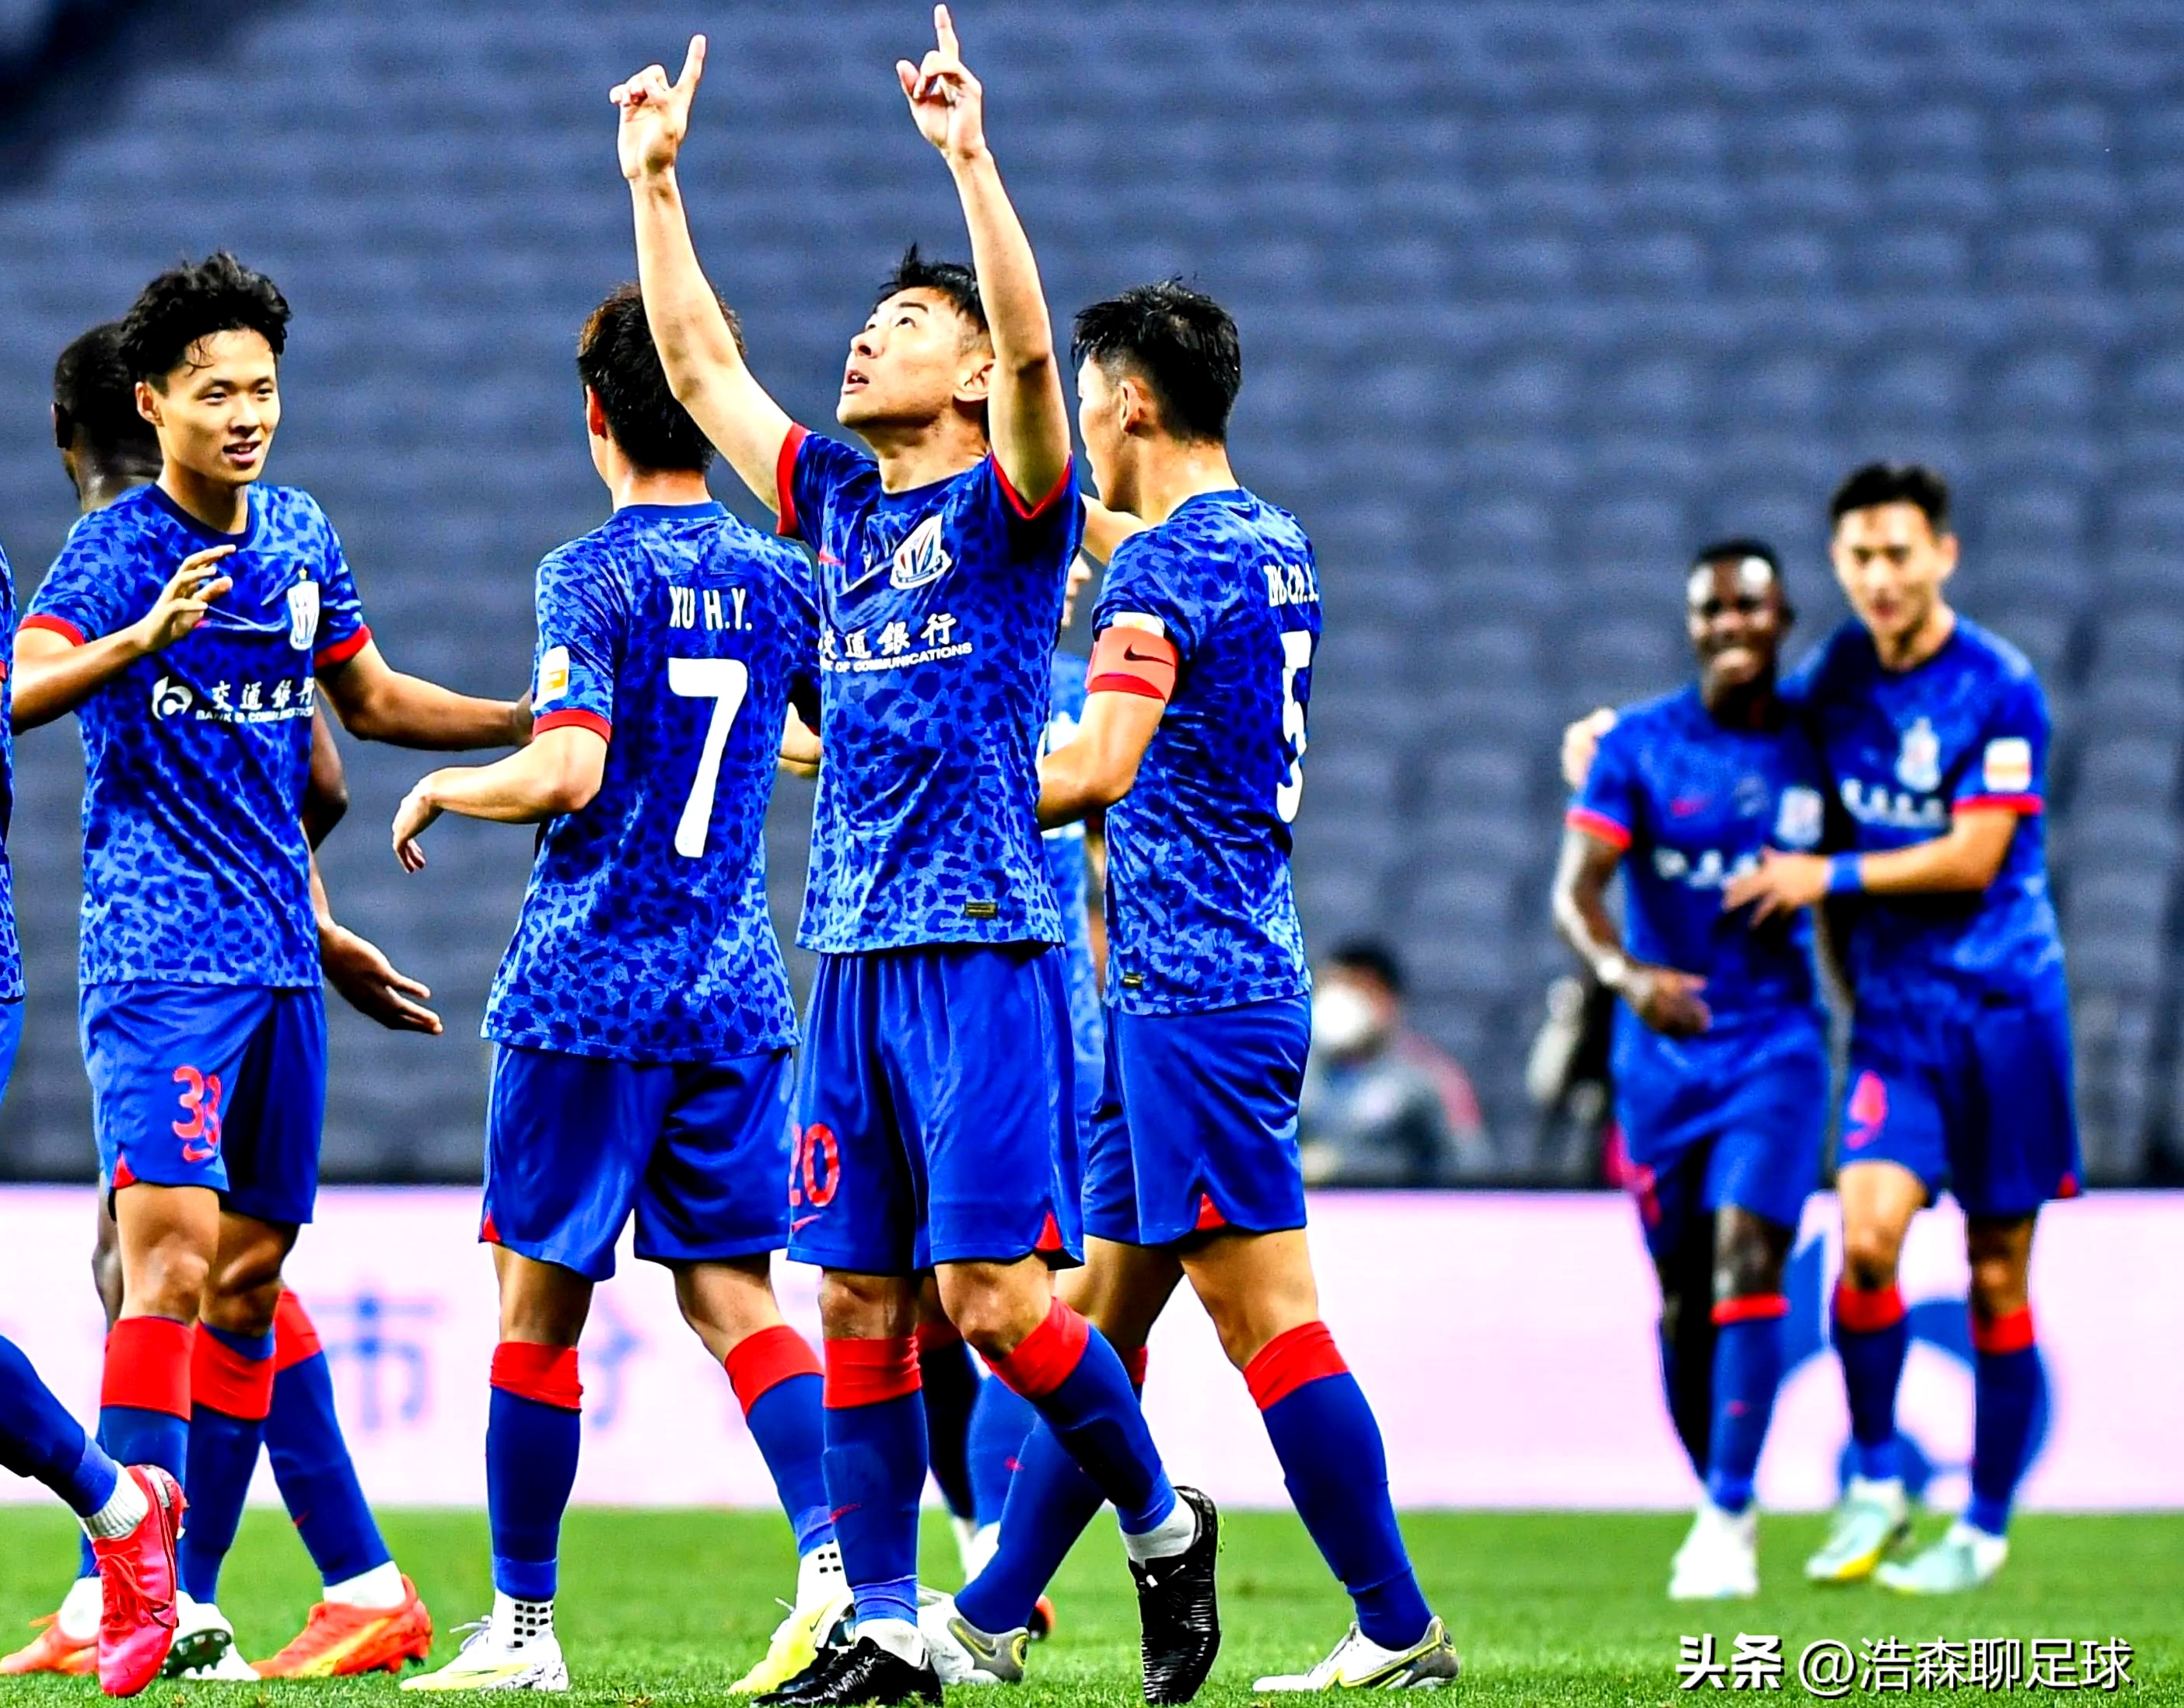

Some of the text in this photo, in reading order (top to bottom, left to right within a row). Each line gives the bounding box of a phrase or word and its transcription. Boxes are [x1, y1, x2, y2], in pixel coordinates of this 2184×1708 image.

[669, 586, 752, 631] XU H.Y.
[853, 642, 973, 673] COMMUNICATIONS
[668, 657, 748, 858] 7
[1276, 630, 1312, 823] 5
